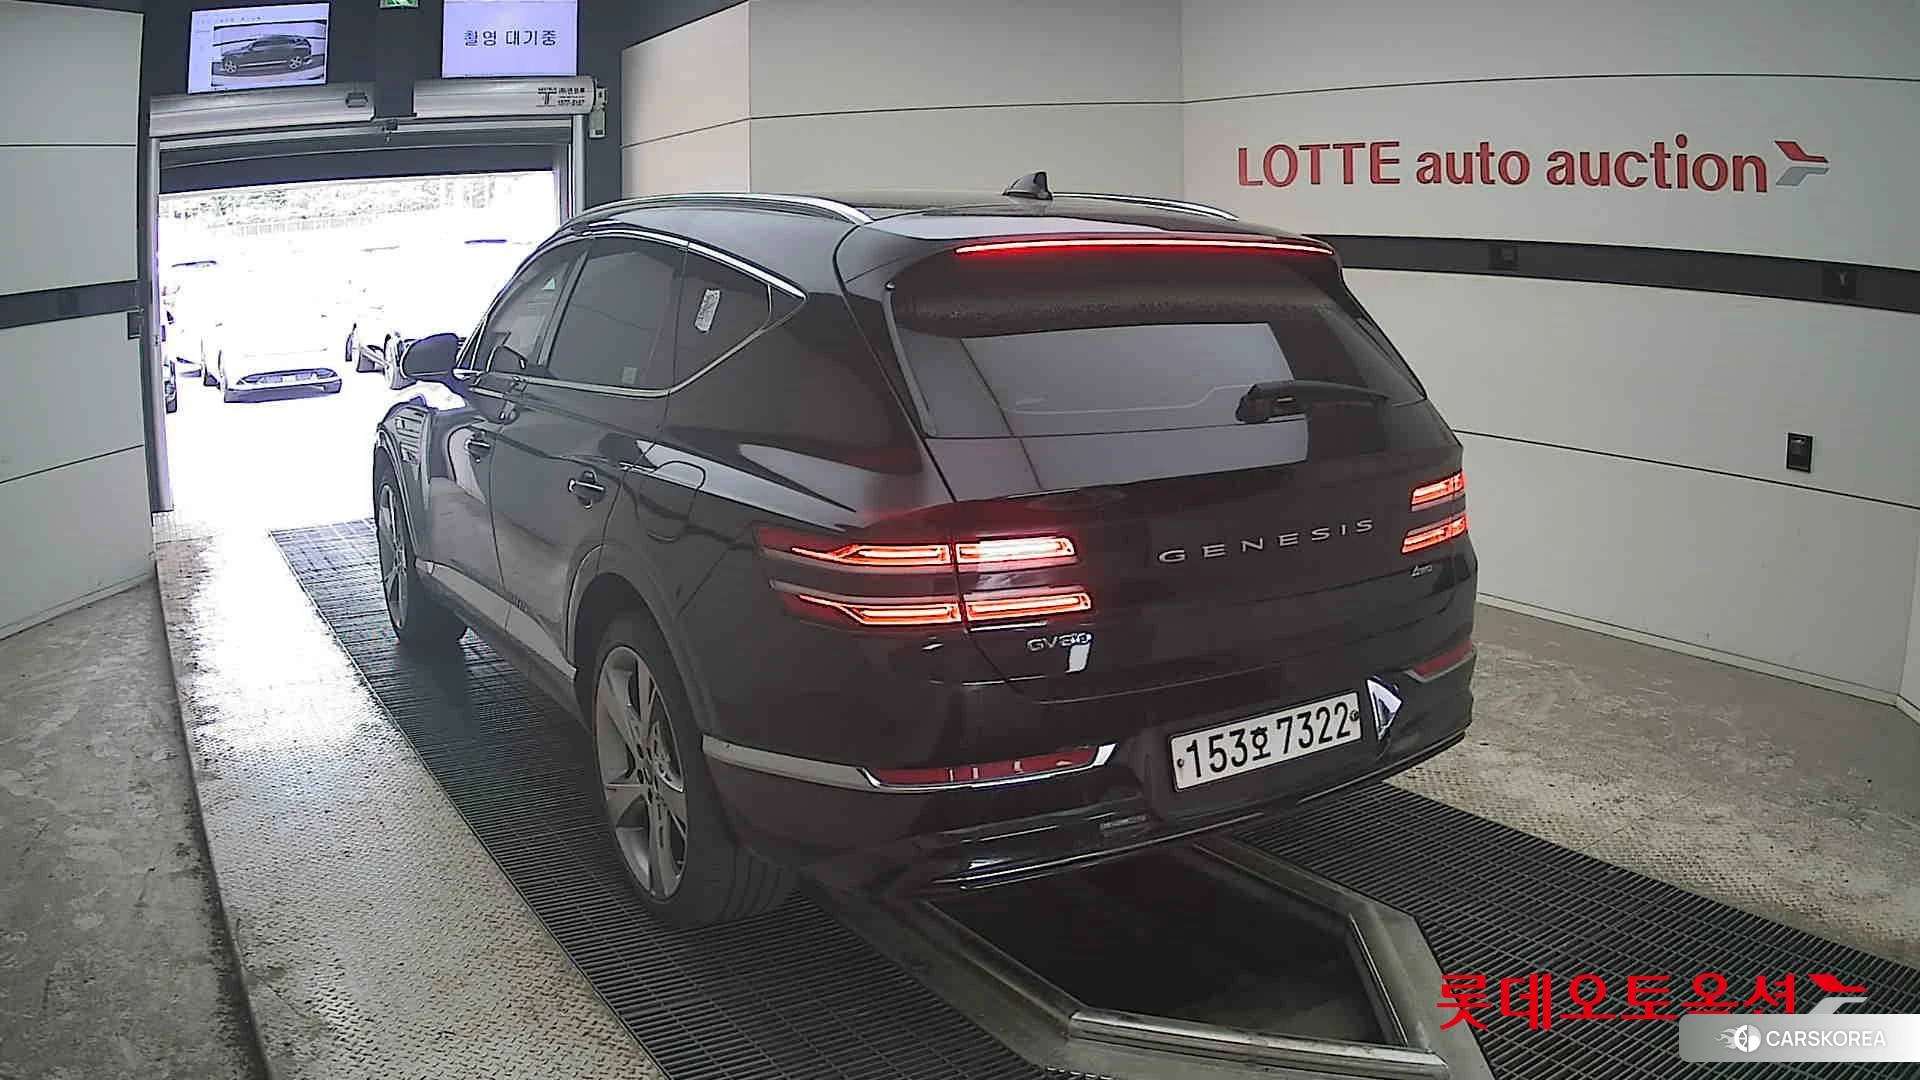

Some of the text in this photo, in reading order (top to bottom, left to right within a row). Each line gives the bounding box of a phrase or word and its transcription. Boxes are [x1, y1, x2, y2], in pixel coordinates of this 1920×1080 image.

[505, 29, 558, 47] 대기중
[1237, 133, 1768, 193] LOTTE auto auction
[1157, 518, 1375, 564] GENESIS
